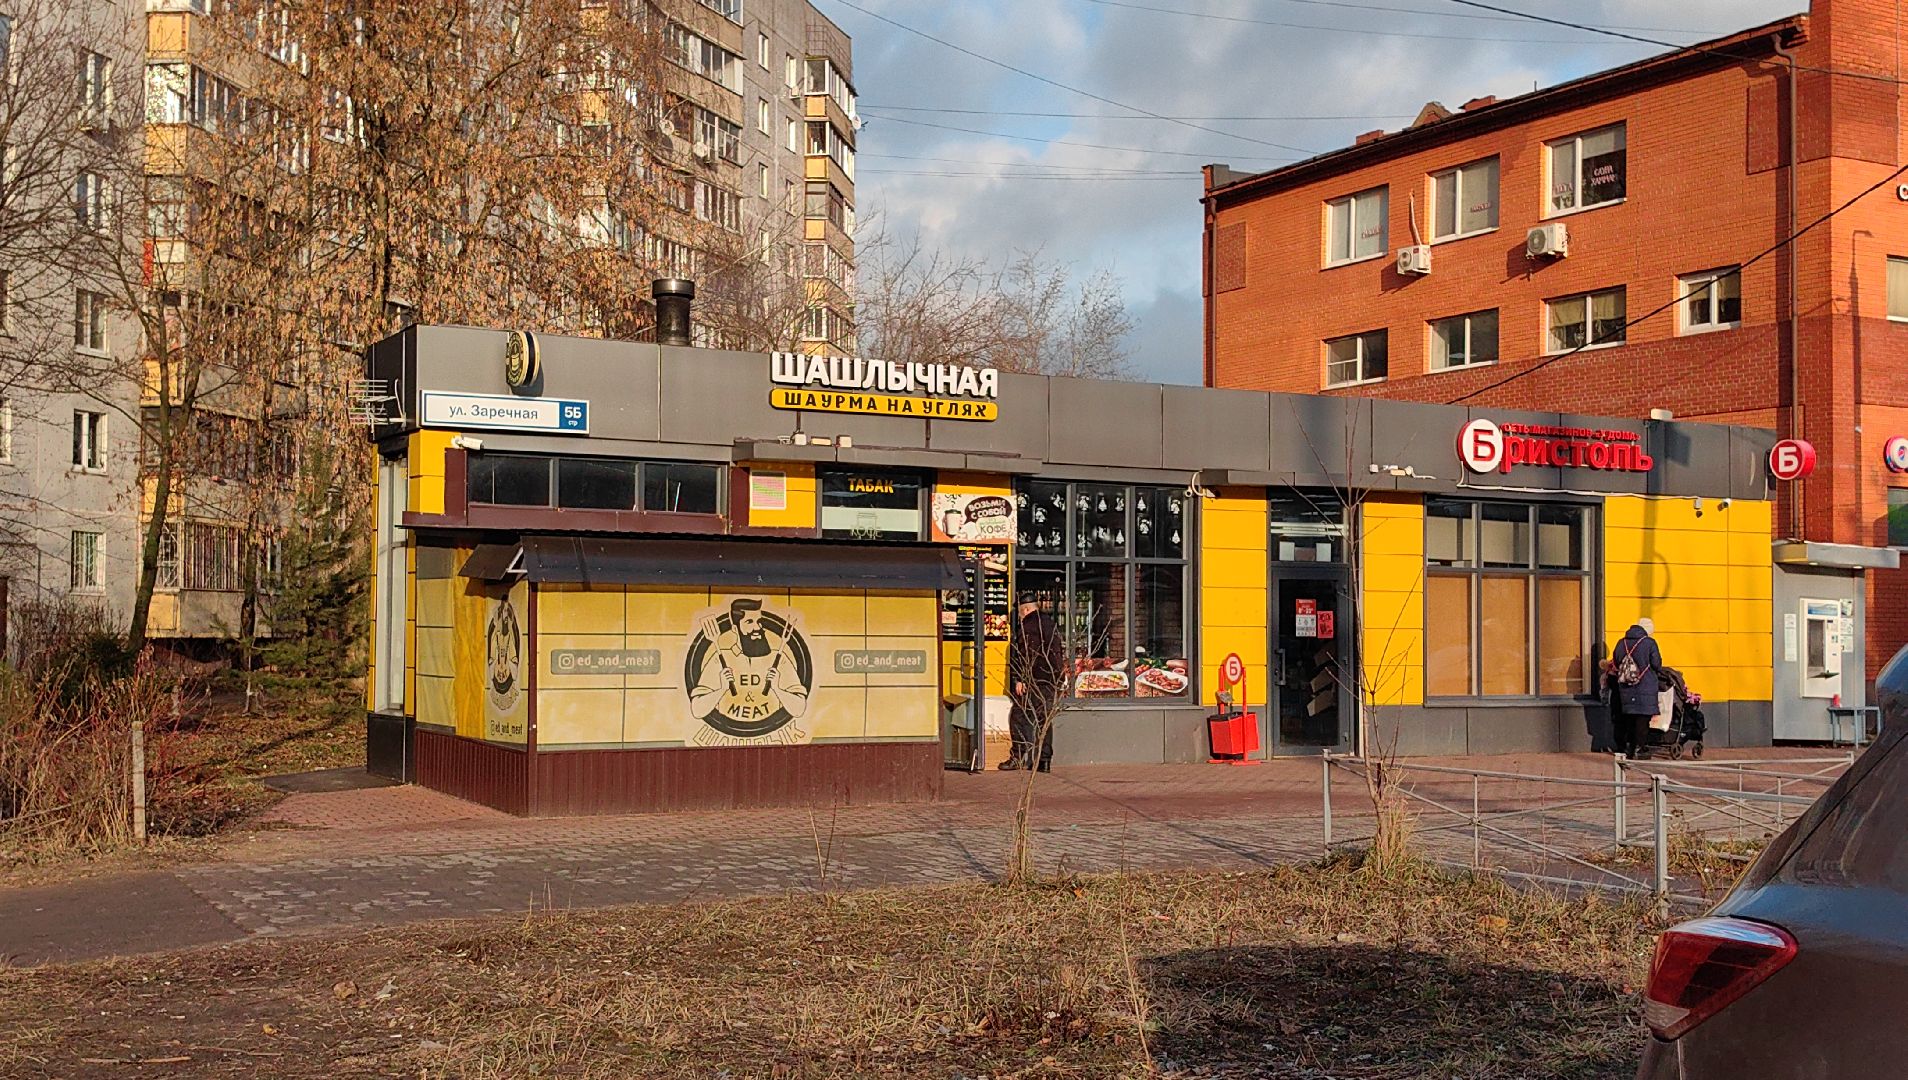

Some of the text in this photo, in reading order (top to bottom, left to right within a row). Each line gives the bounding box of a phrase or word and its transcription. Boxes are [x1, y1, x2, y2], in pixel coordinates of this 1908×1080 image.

[771, 351, 998, 398] ШАШЛЫЧНАЯ
[449, 404, 538, 419] ул. Заречная
[784, 391, 987, 418] ШАУРМА НА УГЛЯХ
[564, 406, 582, 419] 5Б
[568, 419, 578, 427] стр
[1531, 424, 1593, 437] МАГАЗИНОВ
[1472, 428, 1654, 473] Бристоль
[1778, 446, 1799, 472] Б
[848, 478, 894, 494] ТАБАК
[968, 499, 1006, 512] ВОЗЬМИ
[977, 506, 1006, 518] СОБОЙ
[980, 525, 1007, 534] КОФЕ
[577, 654, 654, 669] ed_and_meat
[856, 654, 921, 668] ed_and_meat
[1230, 661, 1238, 676] Б
[740, 674, 761, 686] ED
[745, 691, 755, 703] &
[727, 702, 770, 719] MEAT
